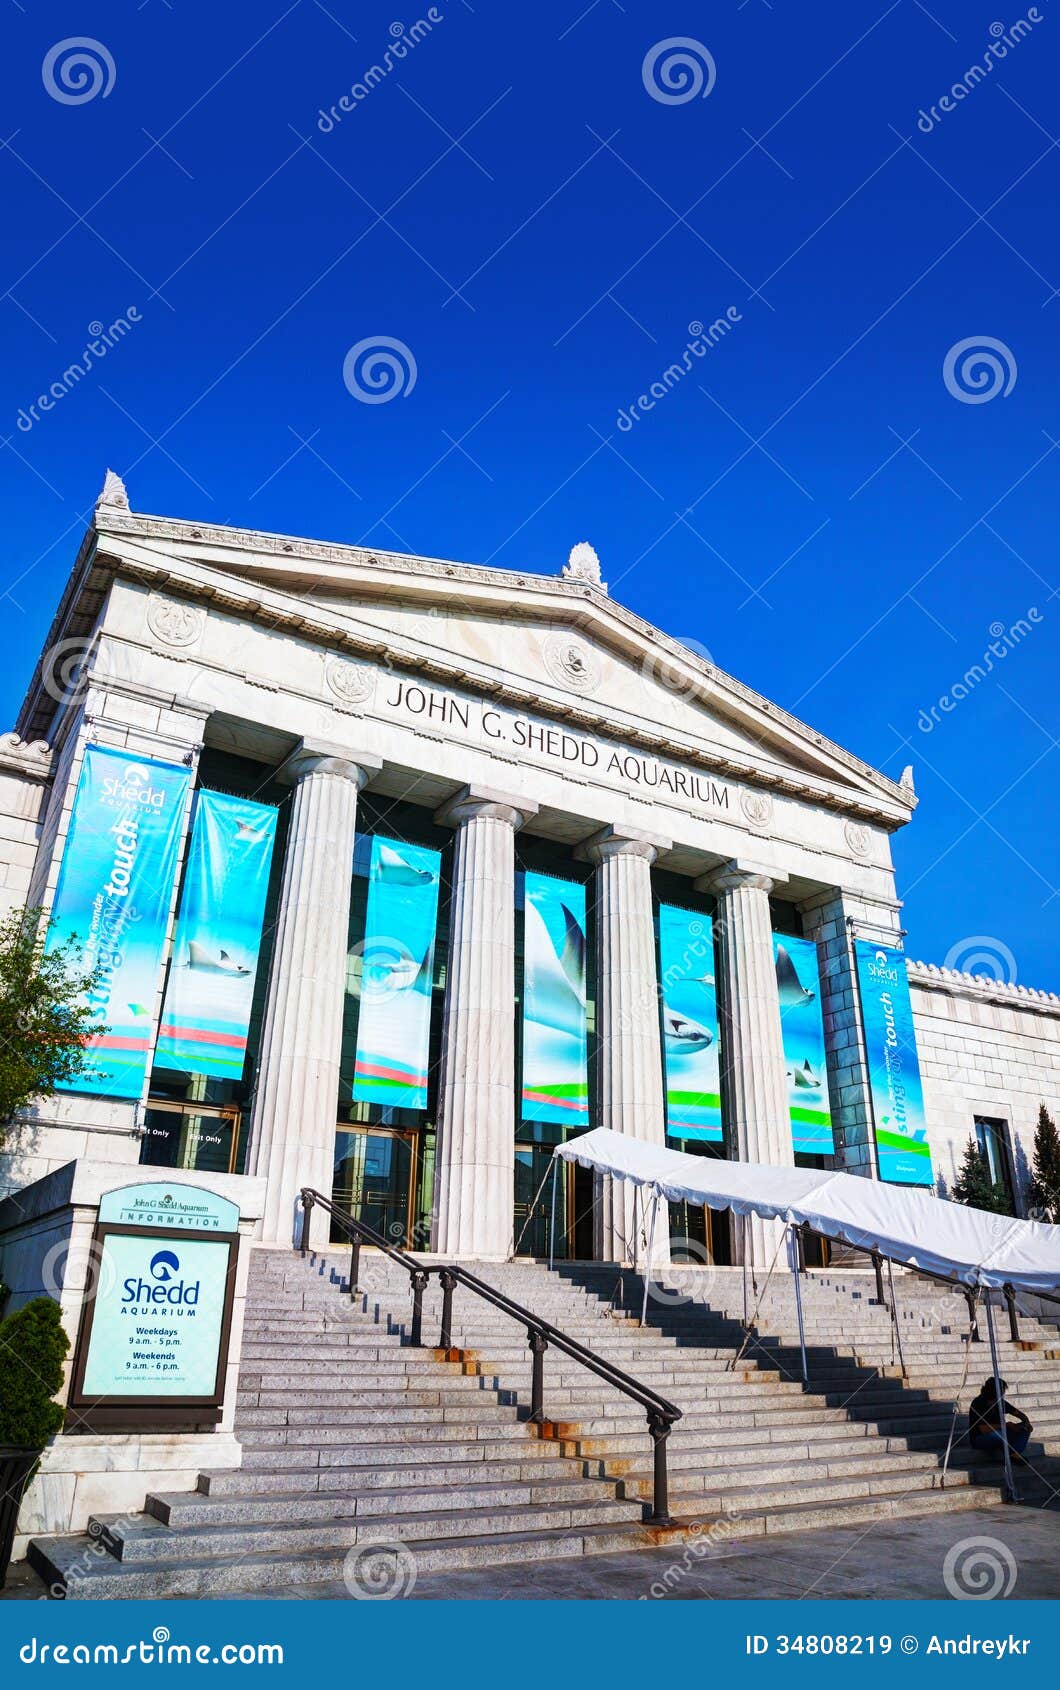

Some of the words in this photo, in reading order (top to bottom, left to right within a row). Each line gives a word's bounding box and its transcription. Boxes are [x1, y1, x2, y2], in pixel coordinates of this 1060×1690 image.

[386, 683, 470, 729] JOHN
[482, 711, 506, 741] G.
[511, 720, 599, 768] SHEDD
[606, 751, 729, 809] AQUARIUM
[101, 777, 166, 808] Shedd
[103, 819, 139, 897] touch
[88, 893, 105, 931] wonder
[867, 962, 898, 981] Shedd
[879, 991, 898, 1048] touch
[888, 1048, 908, 1134] stingray
[152, 1128, 169, 1138] Only
[205, 1135, 222, 1144] Only
[133, 1198, 149, 1208] John
[177, 1202, 209, 1212] Aquarium
[119, 1211, 219, 1227] INFORMATION
[121, 1277, 200, 1305] Shedd
[121, 1306, 196, 1317] AQUARIUM
[136, 1327, 178, 1338] Weekdays
[129, 1337, 134, 1345] 9
[159, 1337, 164, 1345] 5
[165, 1339, 182, 1347] p.m.
[132, 1351, 176, 1360] Weekends
[126, 1361, 131, 1370] 9
[156, 1362, 161, 1370] 6
[162, 1363, 180, 1371] p.m.
